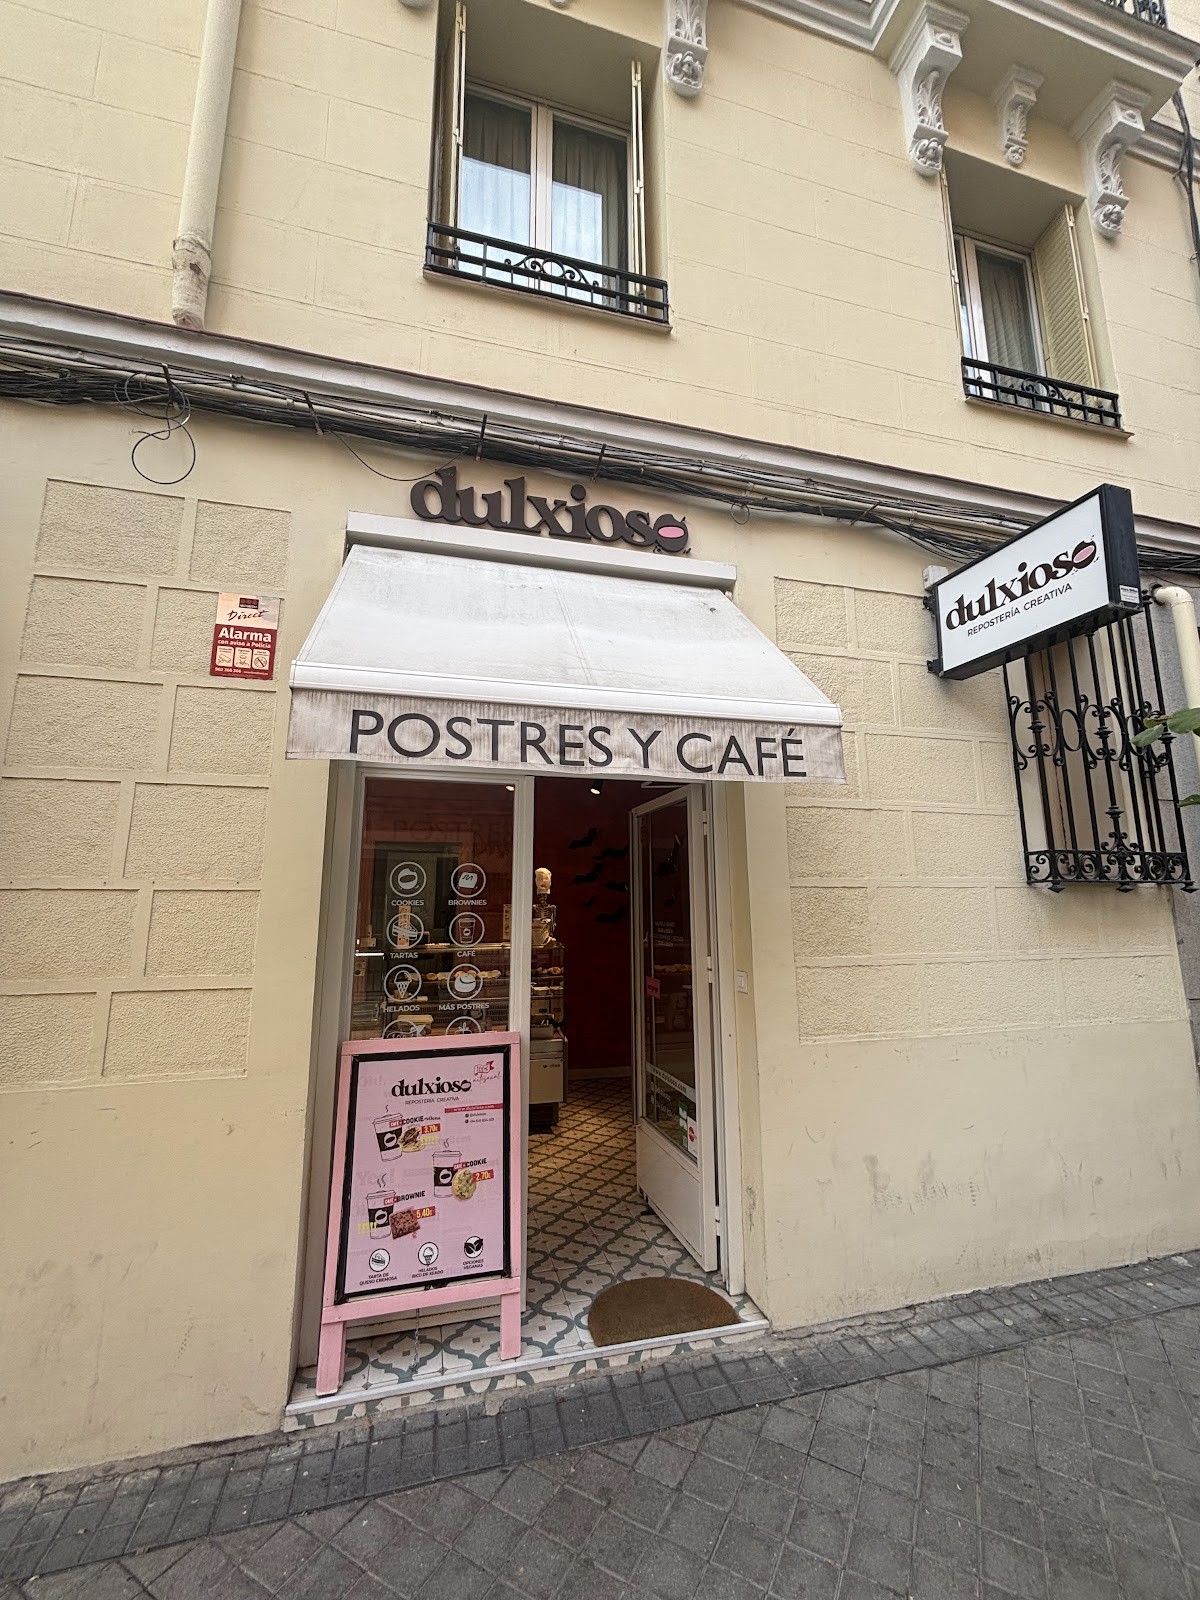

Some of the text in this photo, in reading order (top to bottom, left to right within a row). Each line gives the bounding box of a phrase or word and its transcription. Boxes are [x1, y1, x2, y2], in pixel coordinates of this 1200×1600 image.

[410, 466, 689, 552] dulxioso
[945, 540, 1097, 630] dulxioso
[227, 609, 269, 622] Direct
[967, 582, 1072, 637] REPOSTERÍA CREATIVA
[218, 627, 271, 642] Alarma
[349, 709, 807, 778] POSTRES Y CAFÉ
[439, 1003, 489, 1011] MÁS POSTRES
[391, 1076, 471, 1097] dulxioso
[402, 1116, 424, 1124] COOKIE
[466, 1158, 487, 1167] COOKIE
[397, 1190, 426, 1201] BROWNIE
